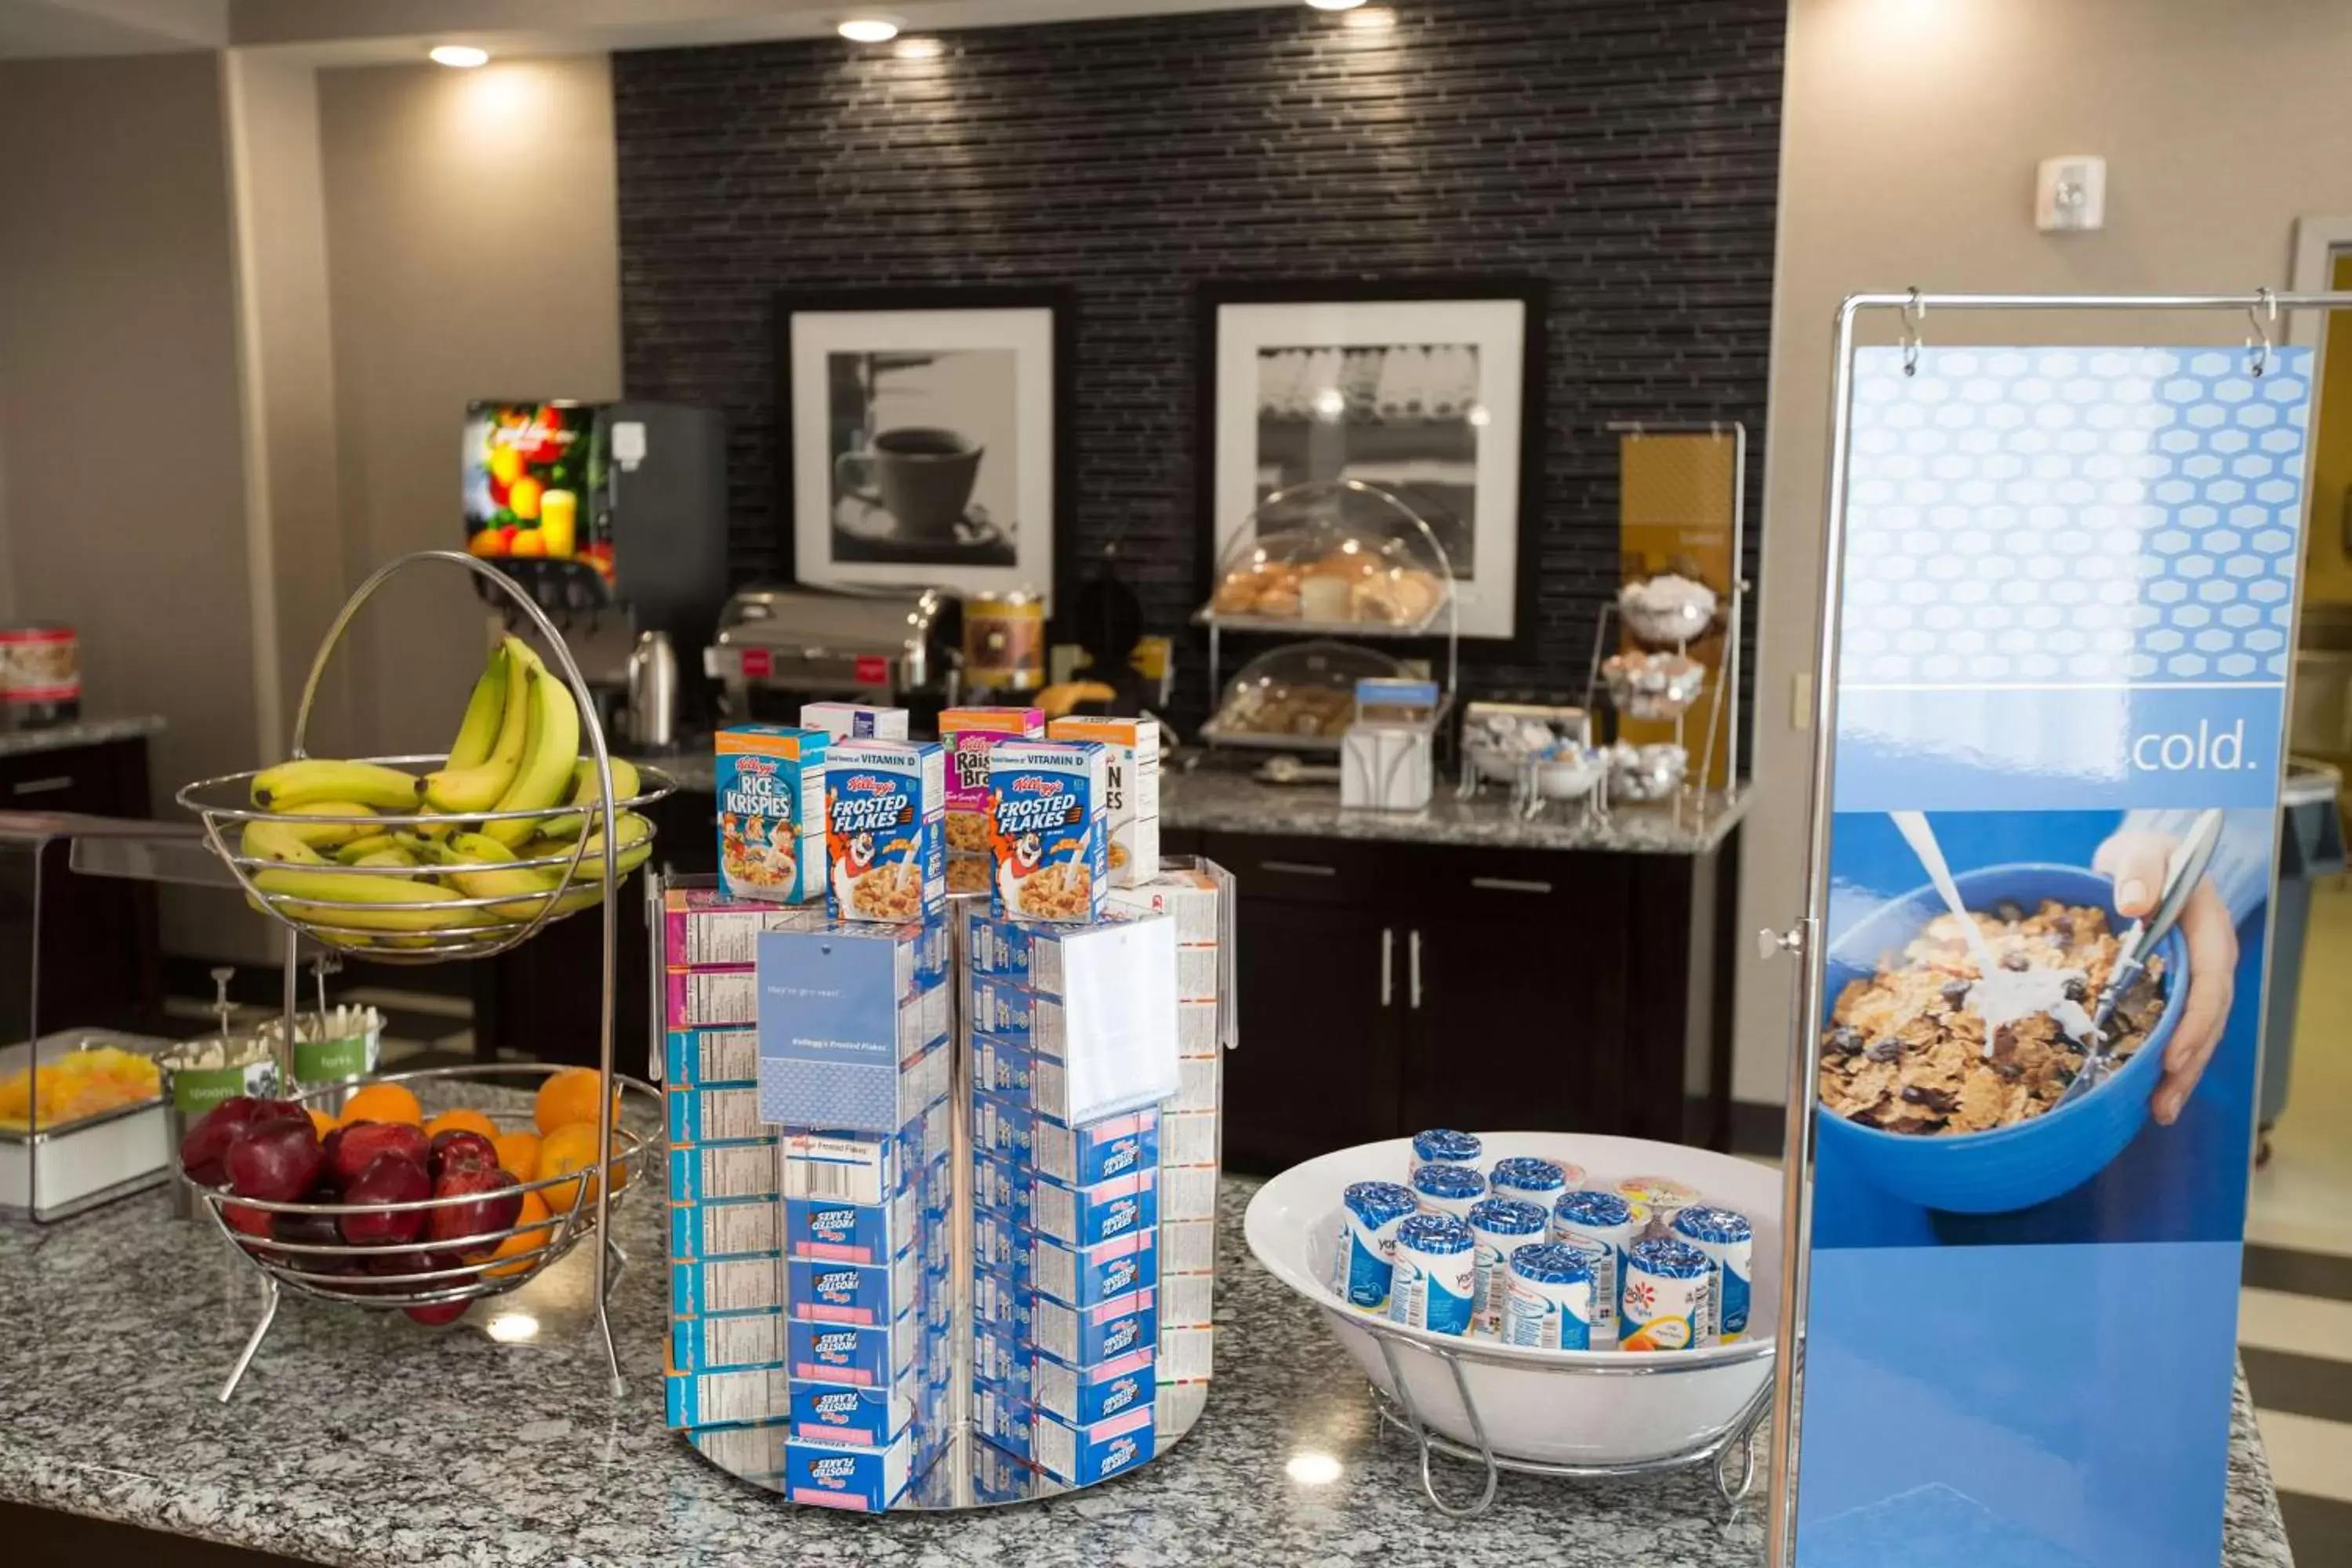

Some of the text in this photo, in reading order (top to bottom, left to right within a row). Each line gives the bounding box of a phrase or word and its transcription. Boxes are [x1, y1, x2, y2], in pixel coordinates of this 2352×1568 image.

[2133, 718, 2256, 771] cold.
[862, 754, 905, 765] VITAMIN
[908, 757, 916, 766] D
[956, 752, 989, 770] Rais
[1028, 755, 1073, 765] VITAMIN
[1076, 757, 1083, 766] D
[742, 775, 772, 797] RICE
[727, 791, 789, 816] KRISPIES
[833, 794, 908, 817] FROSTED
[997, 794, 1076, 818] FROSTED
[834, 811, 898, 833] FLAKES
[999, 811, 1066, 833] FLAKES
[817, 1210, 854, 1221] FLAKES
[812, 1219, 855, 1230] FROSTED
[822, 1272, 858, 1283] FLAKES
[817, 1280, 859, 1291] FROSTED
[821, 1332, 857, 1343] FLAKES
[815, 1341, 857, 1352] FROSTED
[822, 1393, 858, 1403] FLAKES
[815, 1402, 858, 1412] FROSTED
[818, 1458, 855, 1468] FLAKES
[812, 1466, 855, 1477] FROSTED
